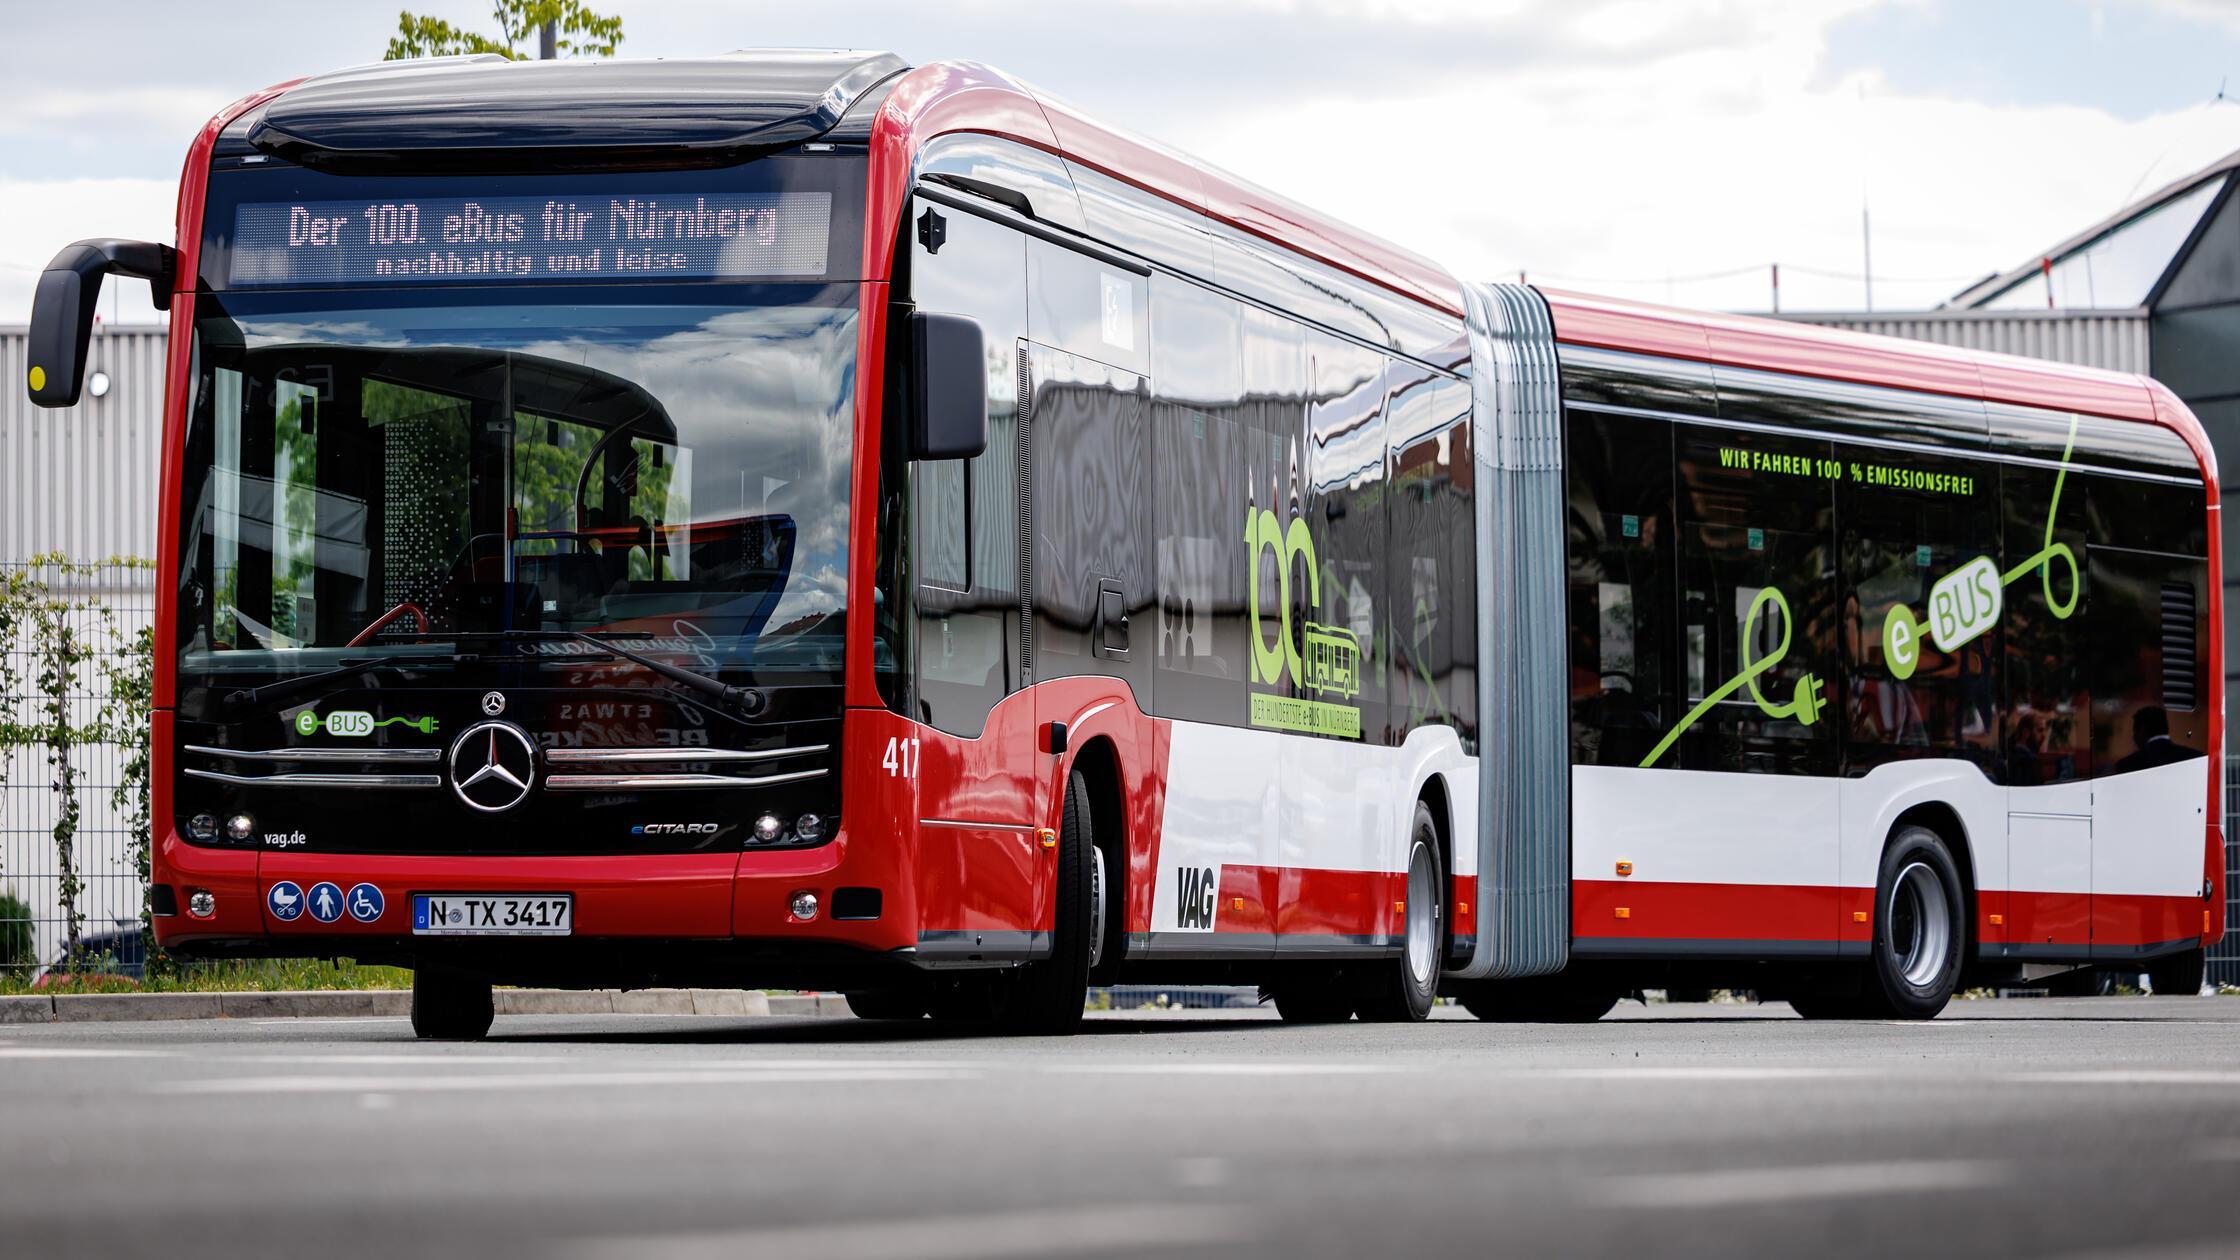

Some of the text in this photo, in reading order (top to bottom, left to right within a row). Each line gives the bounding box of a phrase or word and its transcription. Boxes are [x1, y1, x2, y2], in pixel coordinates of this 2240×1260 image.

[289, 197, 776, 246] Der 100. eBus für Nürnberg
[376, 248, 688, 275] nachhaltig und leise
[1720, 447, 1974, 495] WIR FAHREN 100 % EMISSIONSFREI
[1891, 567, 1995, 665] e BUS
[1254, 699, 1265, 720] DER
[300, 715, 369, 733] e BUS
[882, 736, 920, 778] 417
[264, 830, 306, 848] vag.de
[631, 823, 719, 834] eCITARO
[1178, 867, 1214, 930] VAG
[430, 901, 567, 926] N TX 3417
